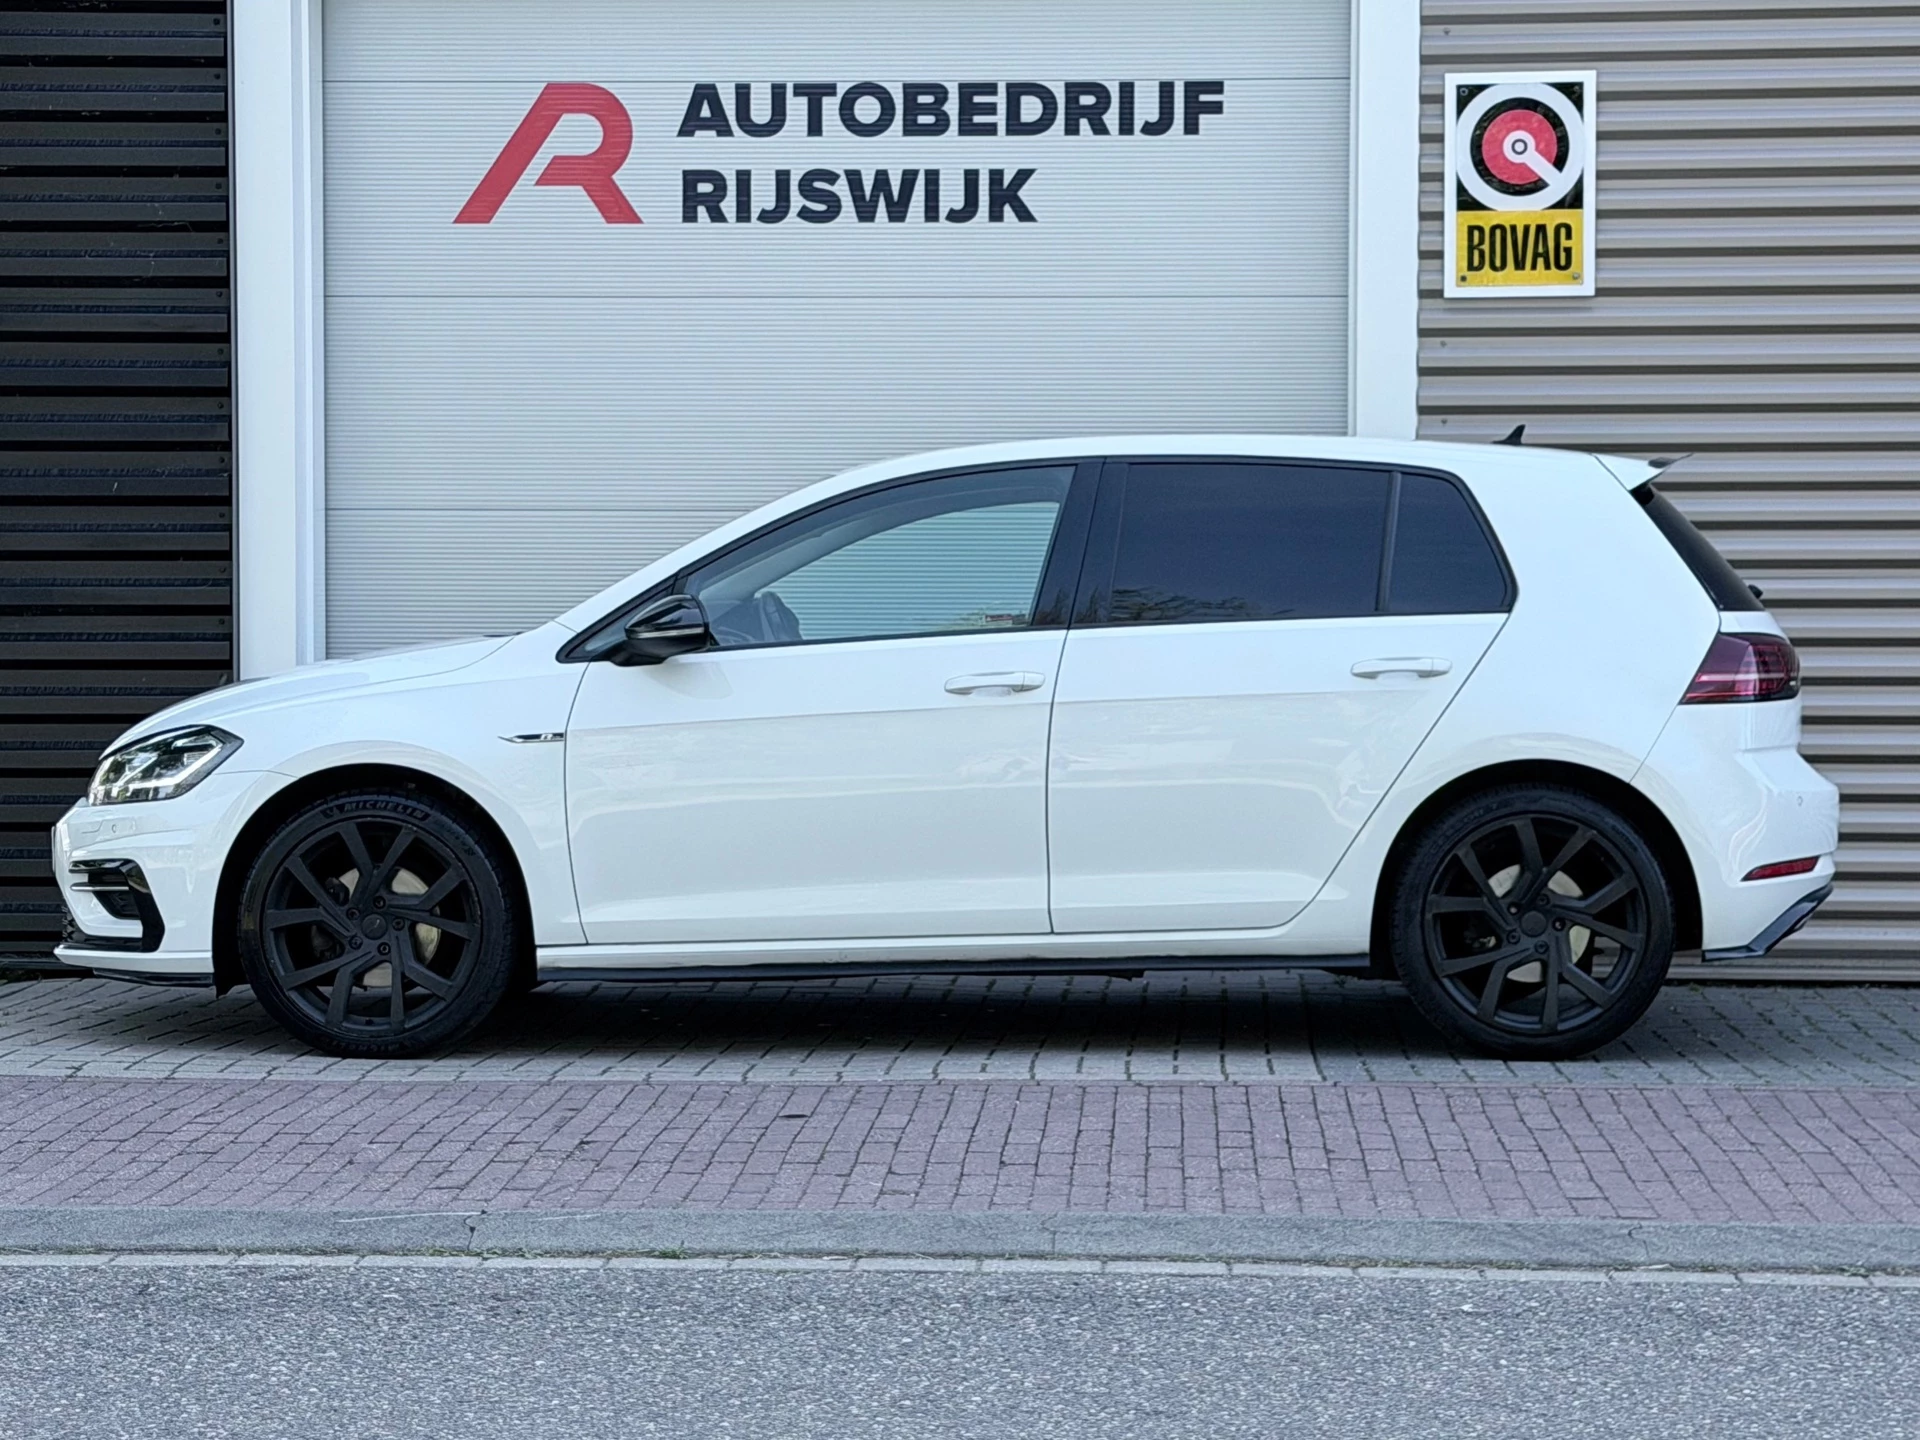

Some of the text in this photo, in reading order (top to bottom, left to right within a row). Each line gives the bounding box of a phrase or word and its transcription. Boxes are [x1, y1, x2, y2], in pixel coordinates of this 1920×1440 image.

[676, 81, 1225, 138] AUTOBEDRIJF
[681, 168, 1038, 224] RIJSWIJK
[1466, 222, 1573, 273] BOVAG
[343, 800, 426, 820] MICHELIN
